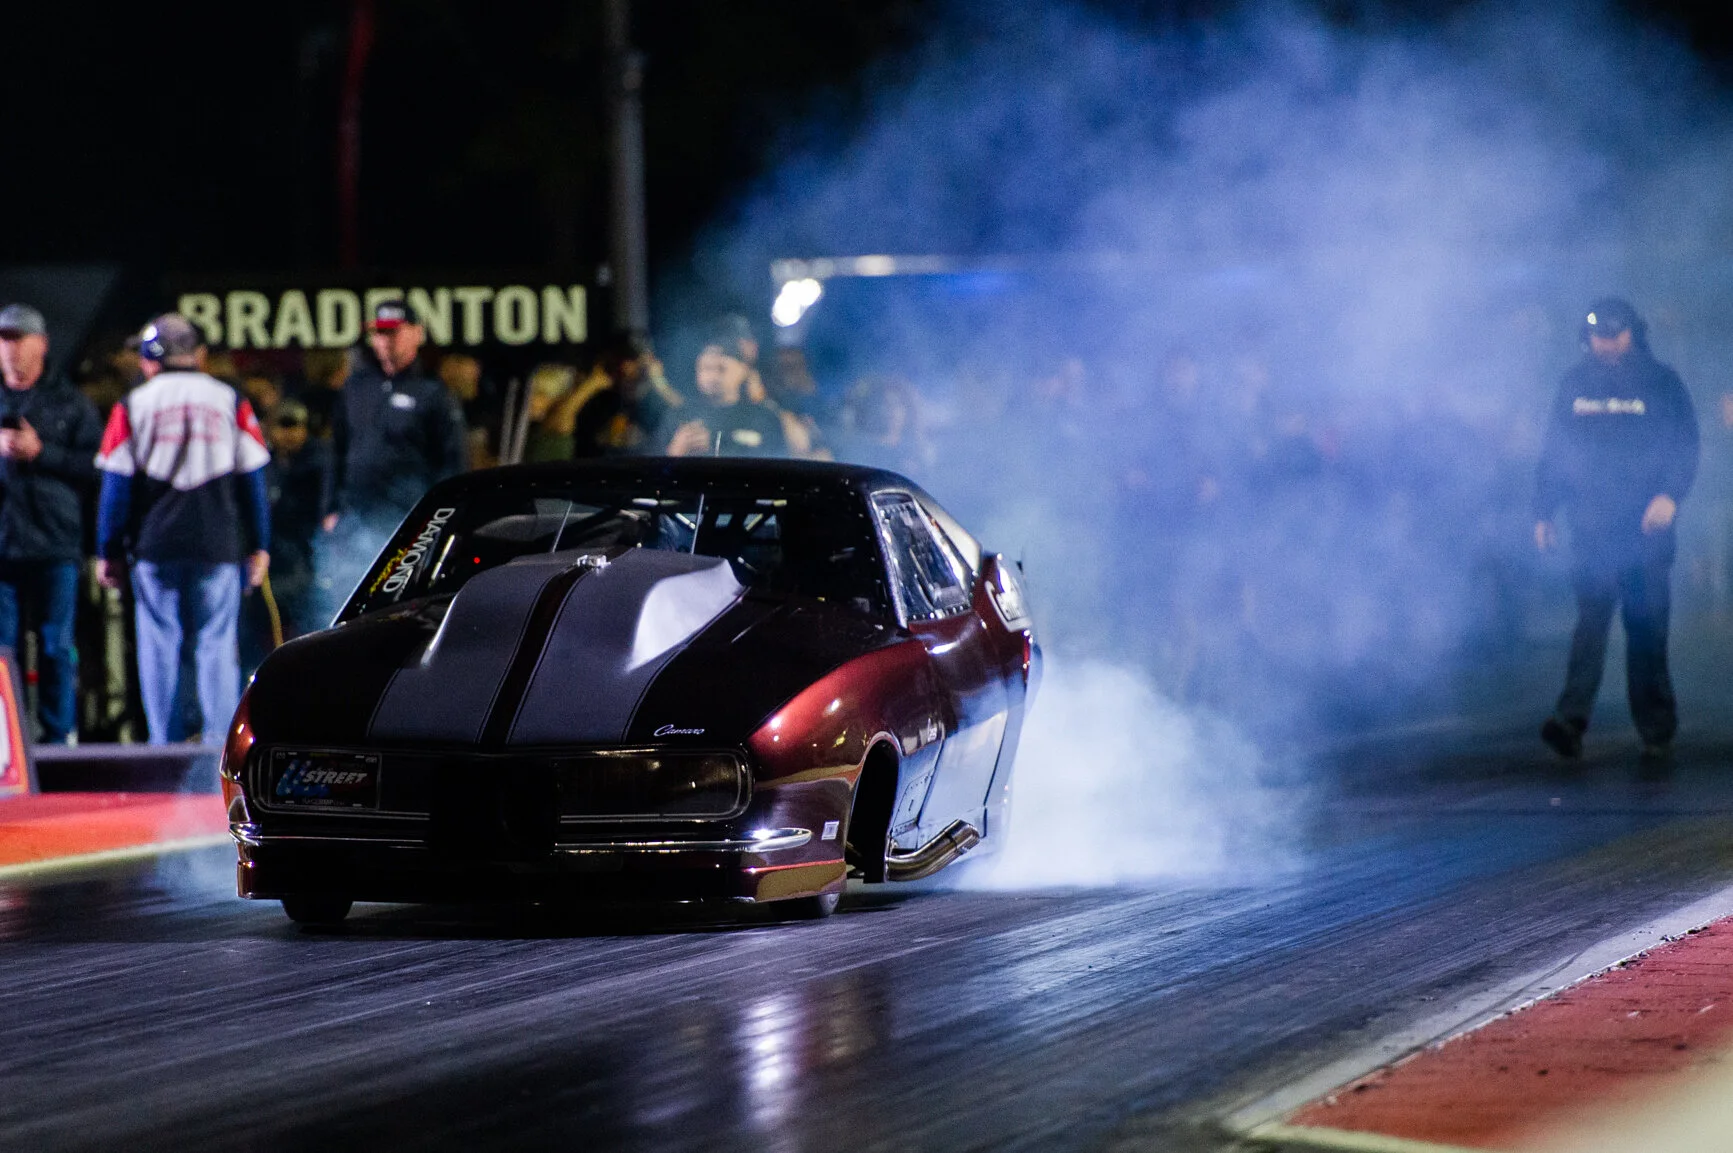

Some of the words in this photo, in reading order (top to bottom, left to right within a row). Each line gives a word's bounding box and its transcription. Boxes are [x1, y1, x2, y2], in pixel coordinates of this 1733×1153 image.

[383, 508, 456, 592] DIAMOND
[653, 723, 705, 737] Camaro
[303, 770, 367, 785] STREET
